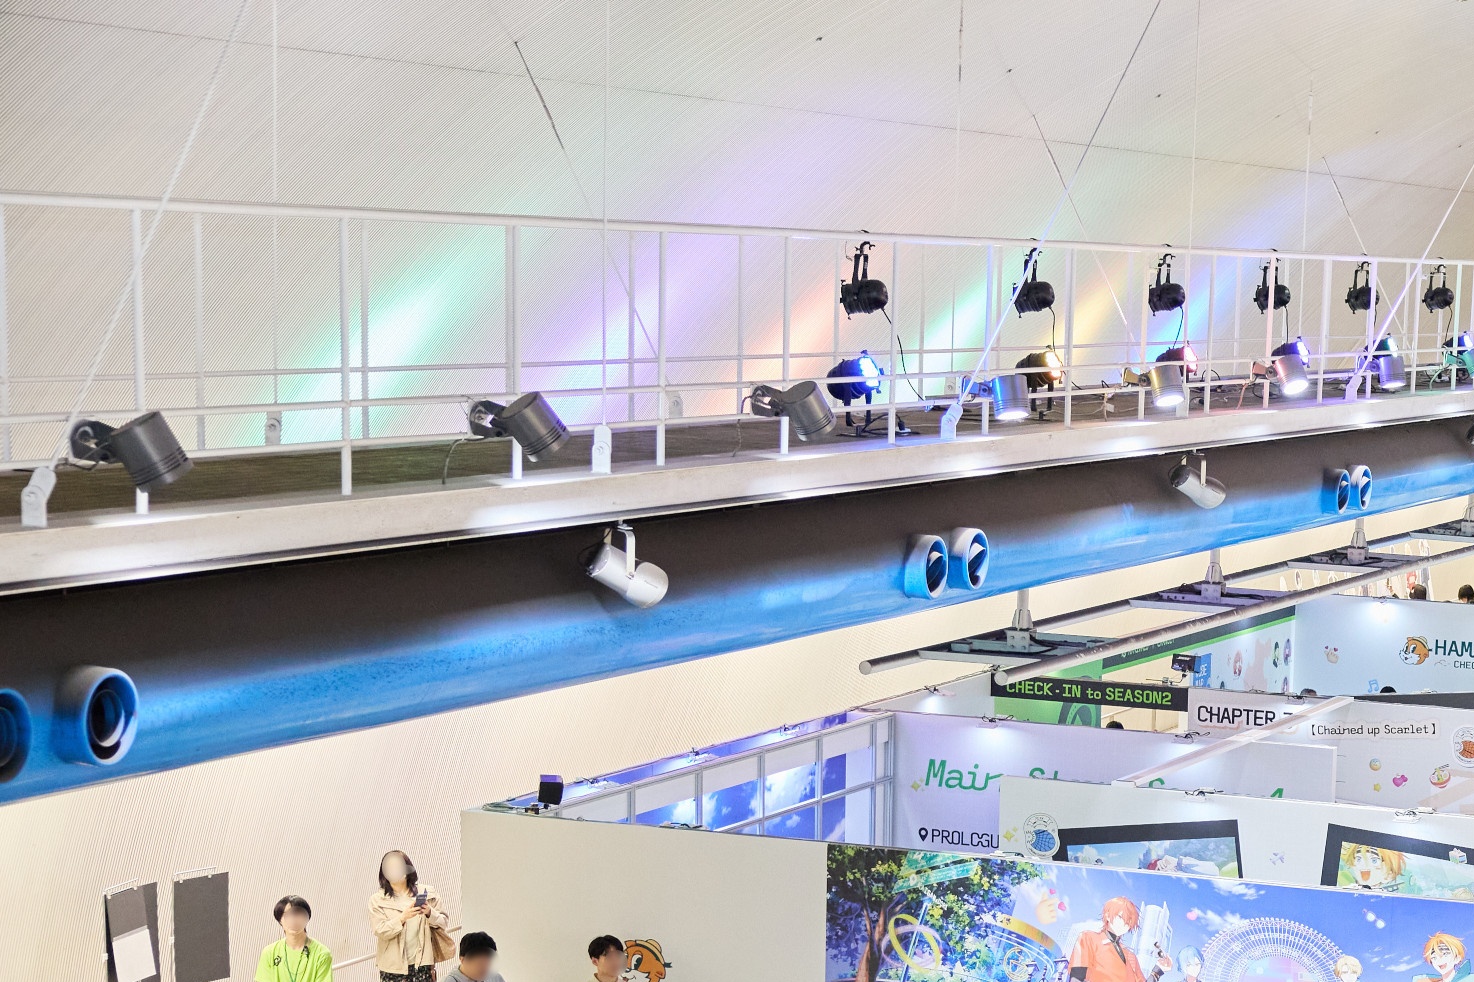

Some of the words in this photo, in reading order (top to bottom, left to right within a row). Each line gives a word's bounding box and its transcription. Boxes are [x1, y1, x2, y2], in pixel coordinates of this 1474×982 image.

[1086, 687, 1102, 700] to
[1105, 687, 1172, 705] SEASON2
[1197, 705, 1276, 727] CHAPTER
[1367, 726, 1380, 738] up
